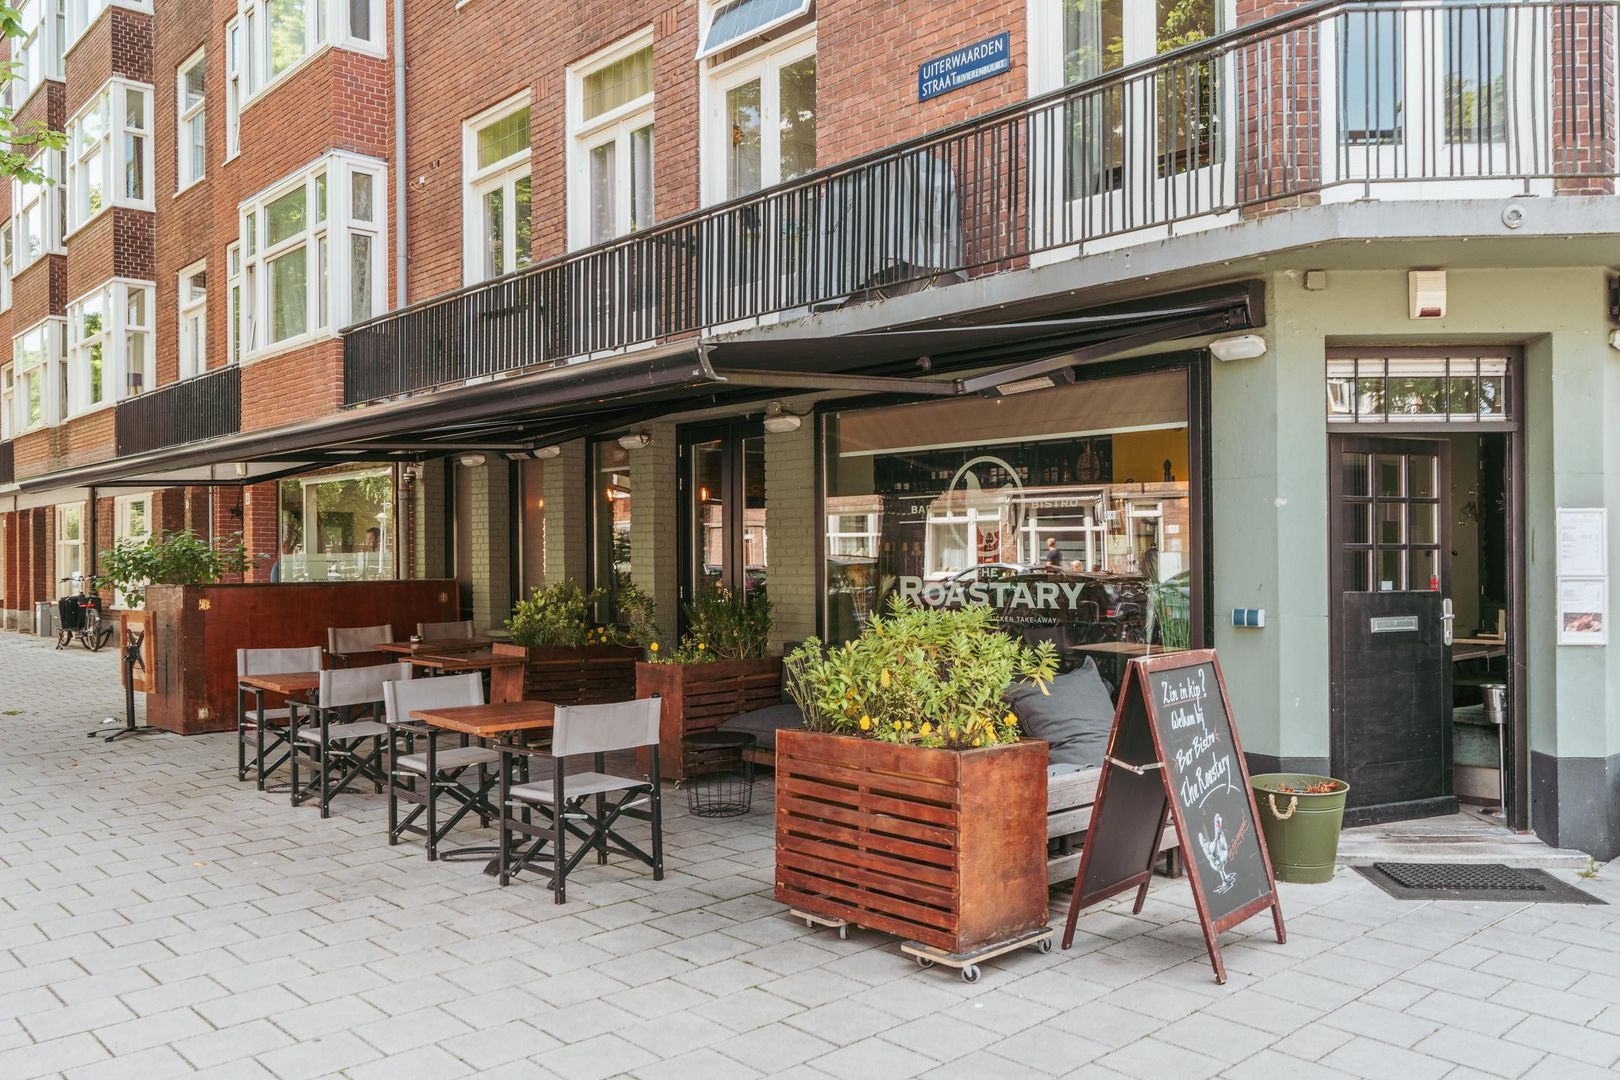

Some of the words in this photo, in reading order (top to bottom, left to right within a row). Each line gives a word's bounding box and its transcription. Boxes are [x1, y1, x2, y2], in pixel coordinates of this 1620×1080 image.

[923, 38, 1003, 79] UITERWAARDEN
[922, 72, 957, 96] STRAAT
[1031, 499, 1078, 508] BISTRO
[900, 576, 1085, 610] ROASTARY
[1016, 616, 1057, 624] TAKE-AWAY
[1161, 681, 1179, 704] Zin
[1179, 682, 1188, 699] in
[1171, 707, 1196, 730] Welkom
[1176, 748, 1193, 774] Bar
[1192, 728, 1215, 759] Bistro
[1180, 775, 1199, 807] The
